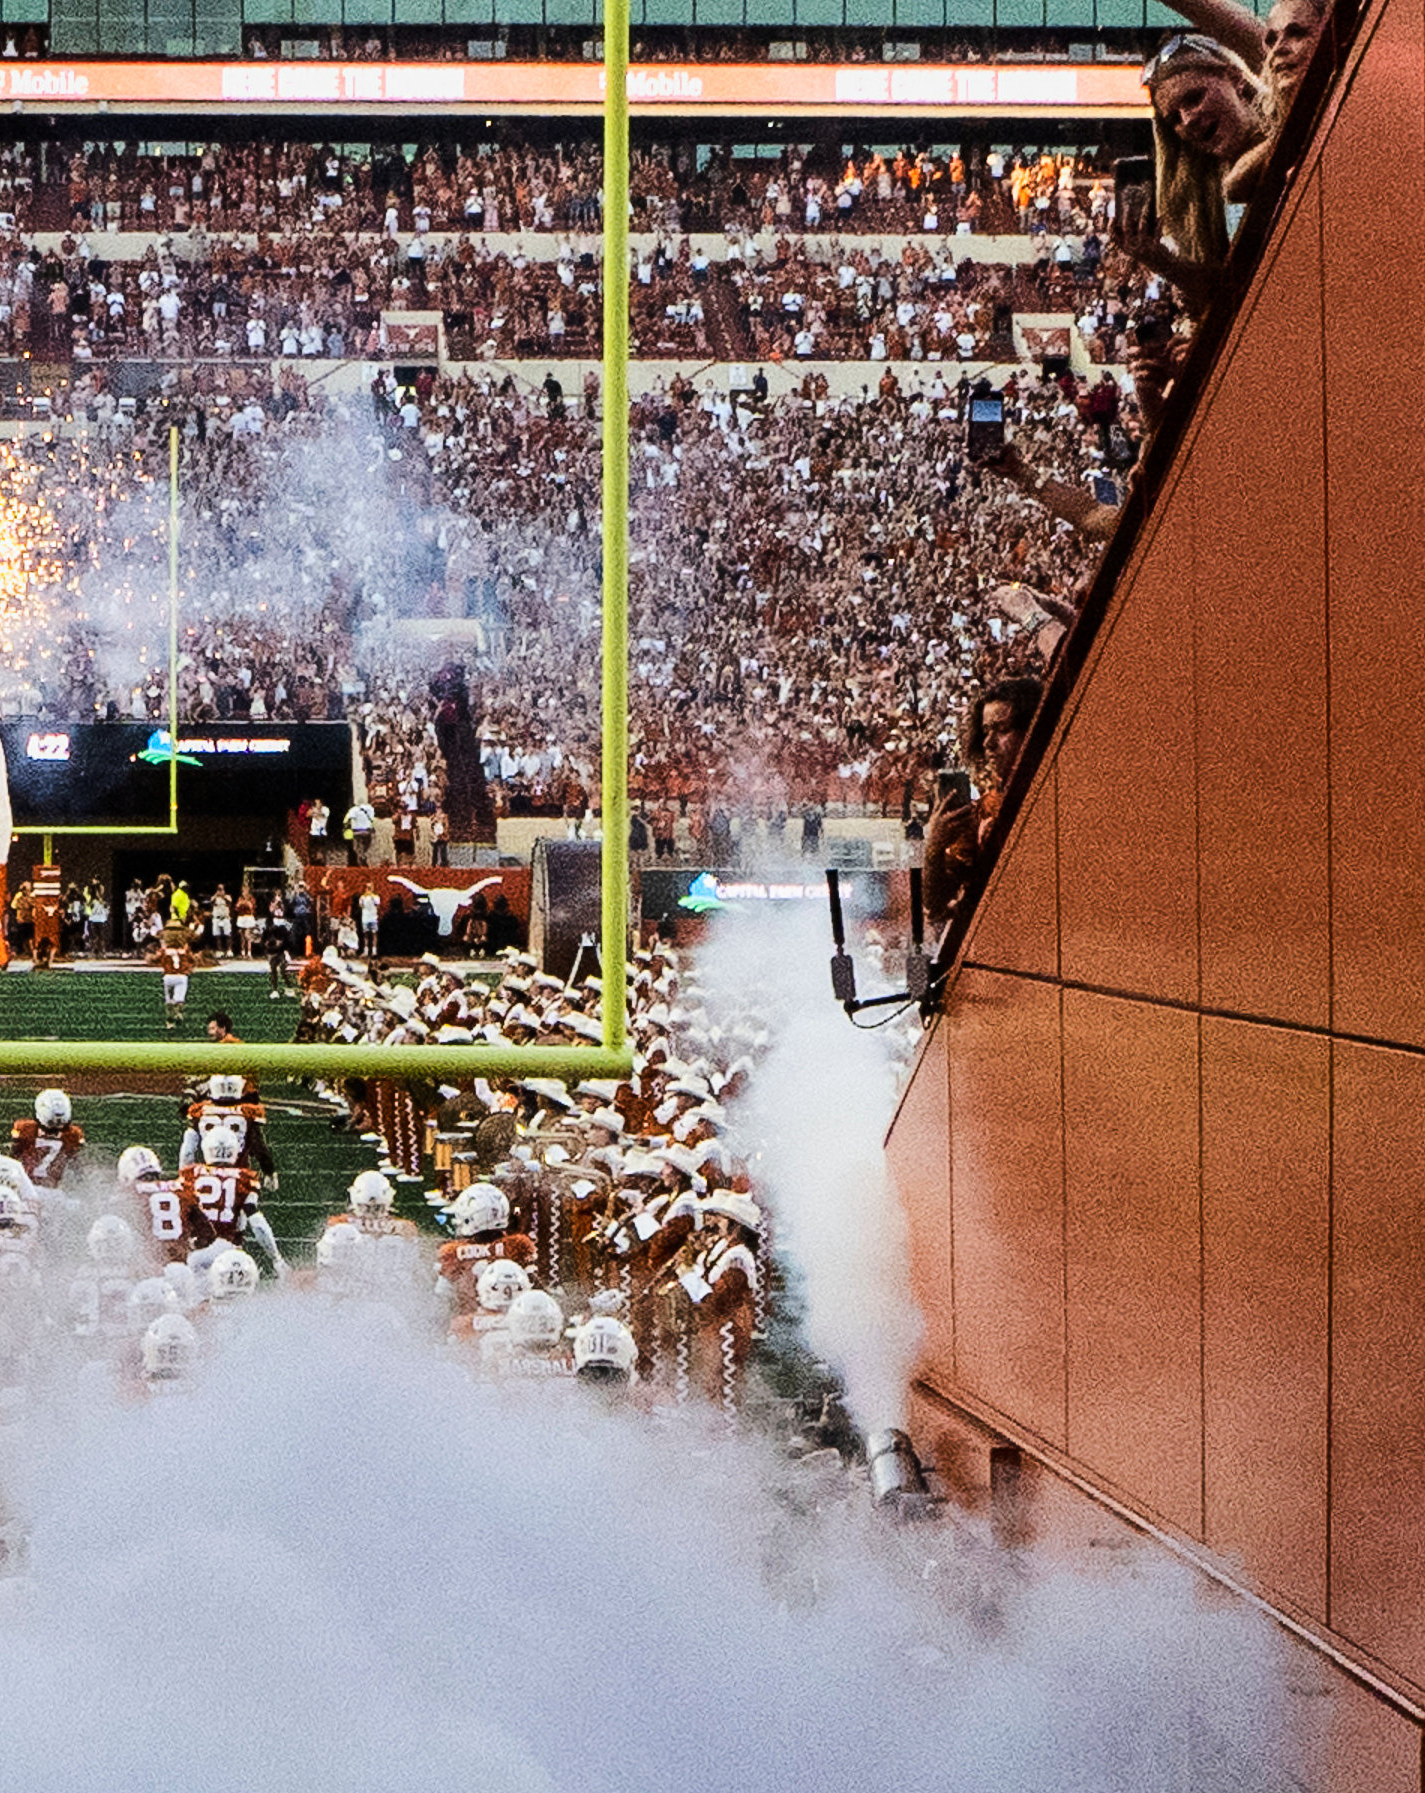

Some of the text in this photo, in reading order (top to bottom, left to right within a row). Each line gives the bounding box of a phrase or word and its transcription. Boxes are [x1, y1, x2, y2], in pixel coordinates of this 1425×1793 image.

[10, 69, 89, 94] Mobile
[626, 71, 702, 96] Mobile
[32, 1138, 63, 1178] 7
[149, 1192, 183, 1240] 8
